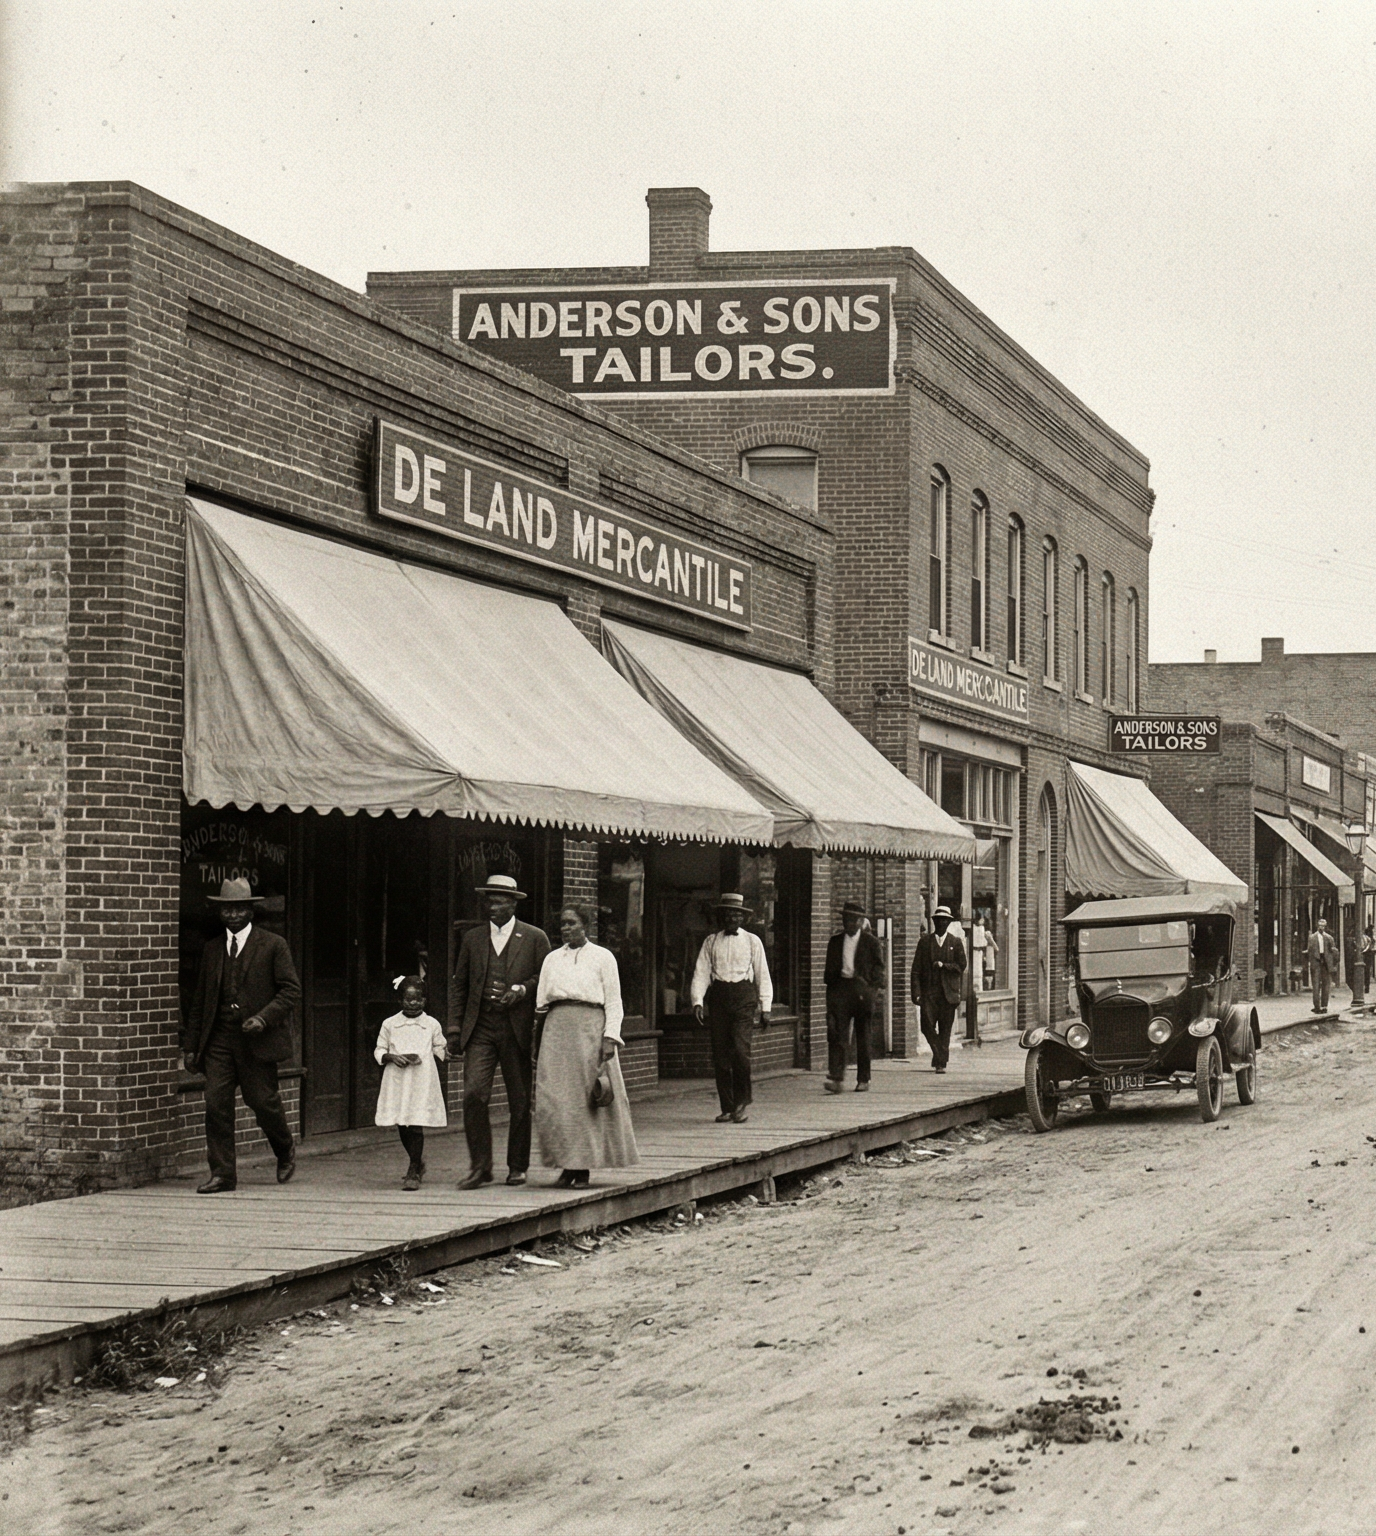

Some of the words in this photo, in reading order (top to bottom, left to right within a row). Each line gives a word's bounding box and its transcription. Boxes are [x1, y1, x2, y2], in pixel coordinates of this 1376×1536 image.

[467, 299, 702, 340] ANDERSON
[716, 300, 749, 335] &
[763, 295, 881, 334] SONS
[559, 343, 835, 384] TAILORS.
[394, 443, 447, 516] DE
[463, 468, 558, 550] LAND
[572, 509, 744, 615] MERCANTILE
[911, 648, 927, 680] DE
[928, 654, 954, 689] LAND
[1113, 720, 1175, 735] ANDERSON
[1176, 721, 1186, 735] &
[1186, 720, 1218, 736] SONS
[1121, 735, 1207, 750] TAILORS
